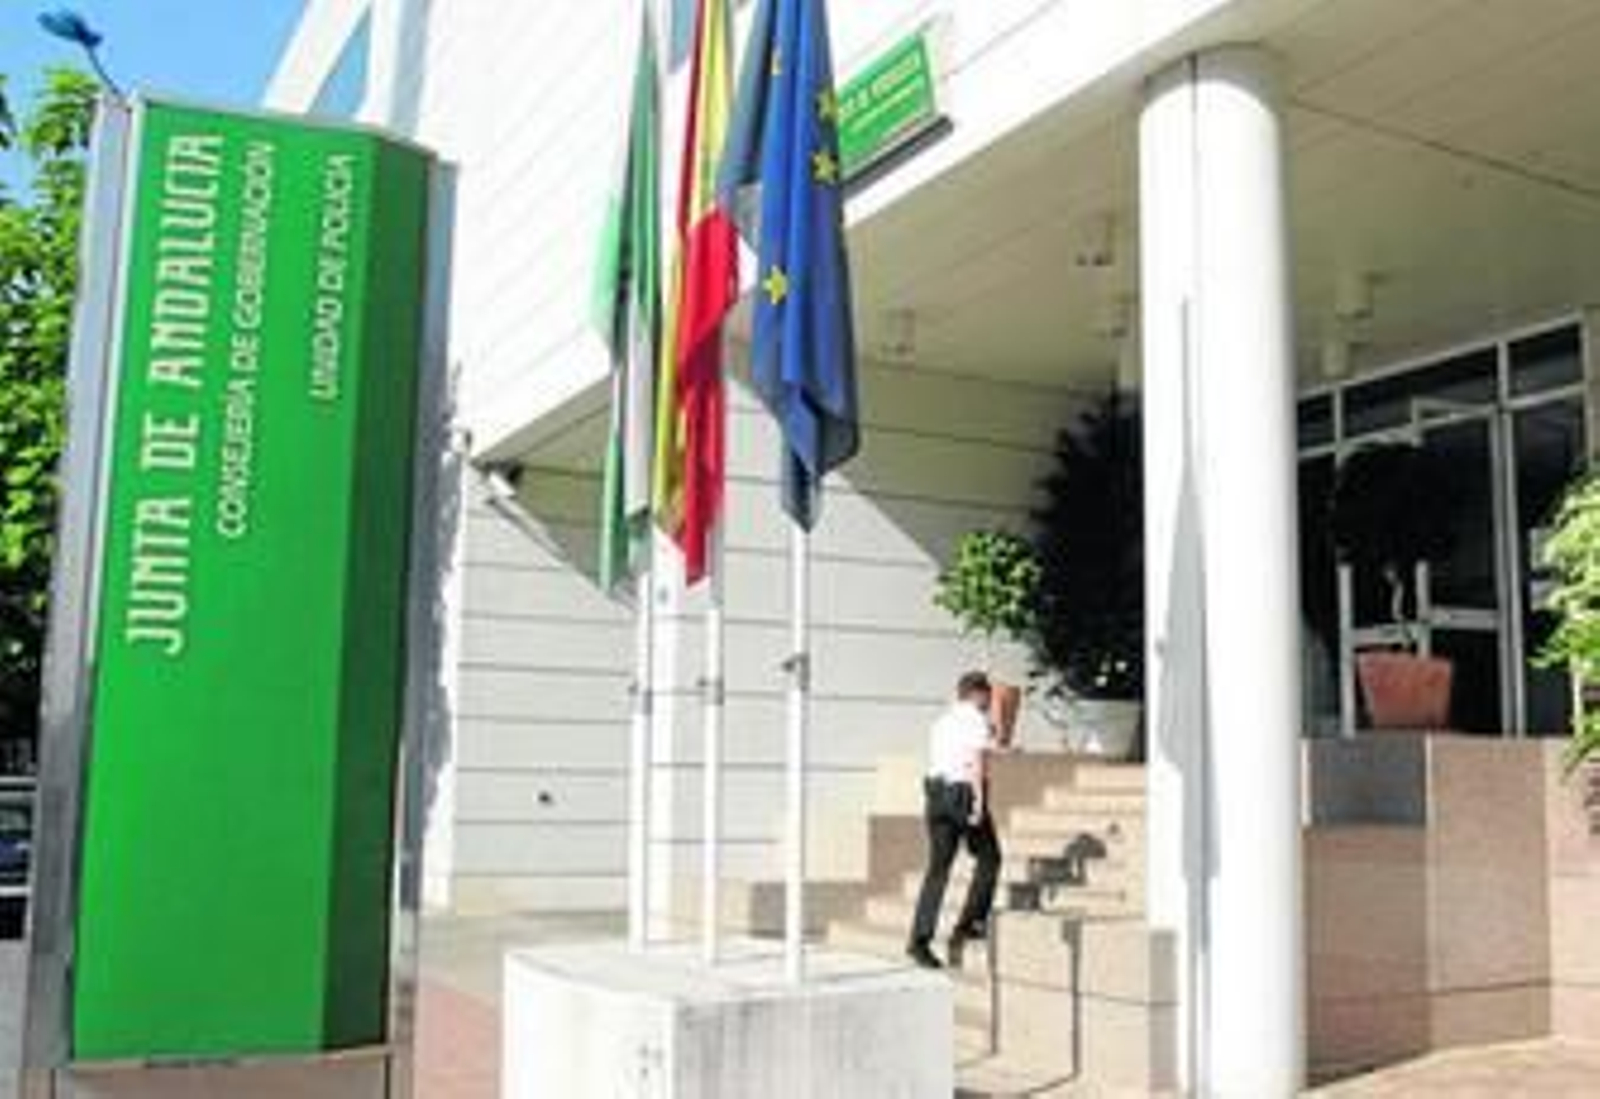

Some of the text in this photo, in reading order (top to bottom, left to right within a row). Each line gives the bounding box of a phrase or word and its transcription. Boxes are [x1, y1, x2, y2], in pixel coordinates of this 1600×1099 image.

[317, 256, 347, 292] DE
[229, 332, 261, 372] DE
[308, 296, 343, 400] UNIDAD
[140, 413, 199, 472] DE
[125, 498, 192, 655] JUNTA
